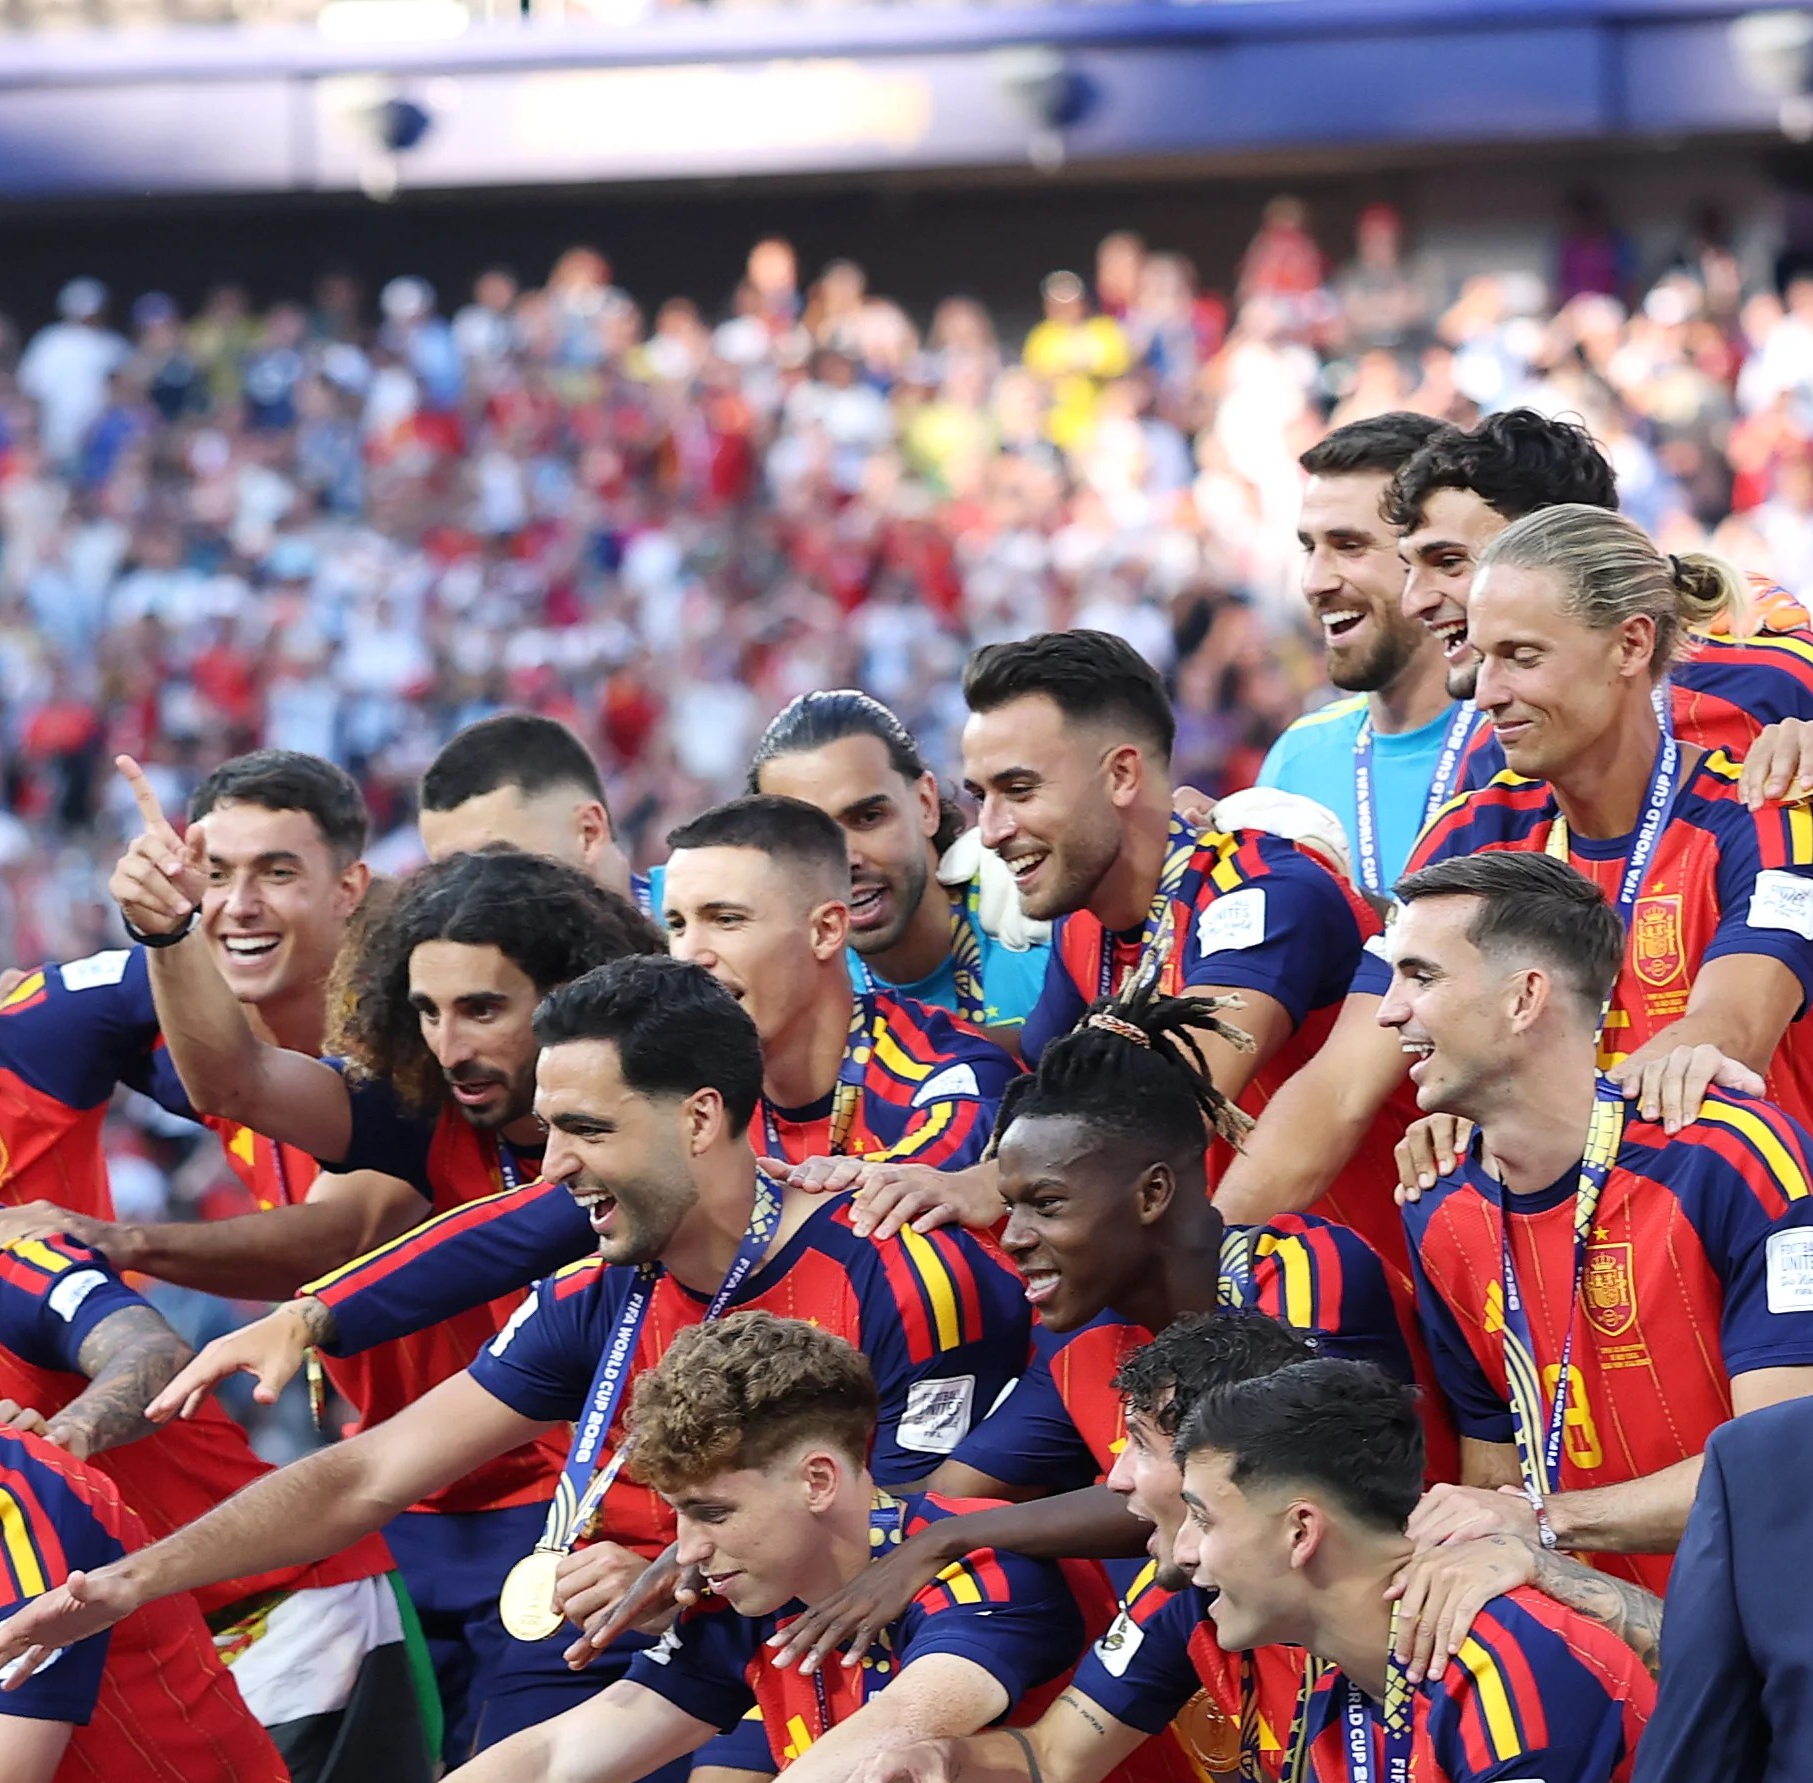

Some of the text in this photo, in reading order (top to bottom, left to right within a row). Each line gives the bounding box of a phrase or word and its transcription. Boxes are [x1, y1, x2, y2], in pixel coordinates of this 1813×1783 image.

[1425, 782, 1447, 823] ORLD
[1437, 750, 1457, 782] CUP
[1651, 775, 1672, 808] CUP
[1356, 766, 1379, 890] FIFA WORLD CUP
[1630, 808, 1662, 867] WORLD
[1621, 868, 1641, 904] FIFA
[706, 1257, 752, 1323] FIFA WO
[575, 1292, 645, 1464] FIFA WORLD CUP 2026
[1546, 1430, 1560, 1467] FIFA
[1347, 1679, 1364, 1726] ORLD
[1349, 1726, 1367, 1765] CUP
